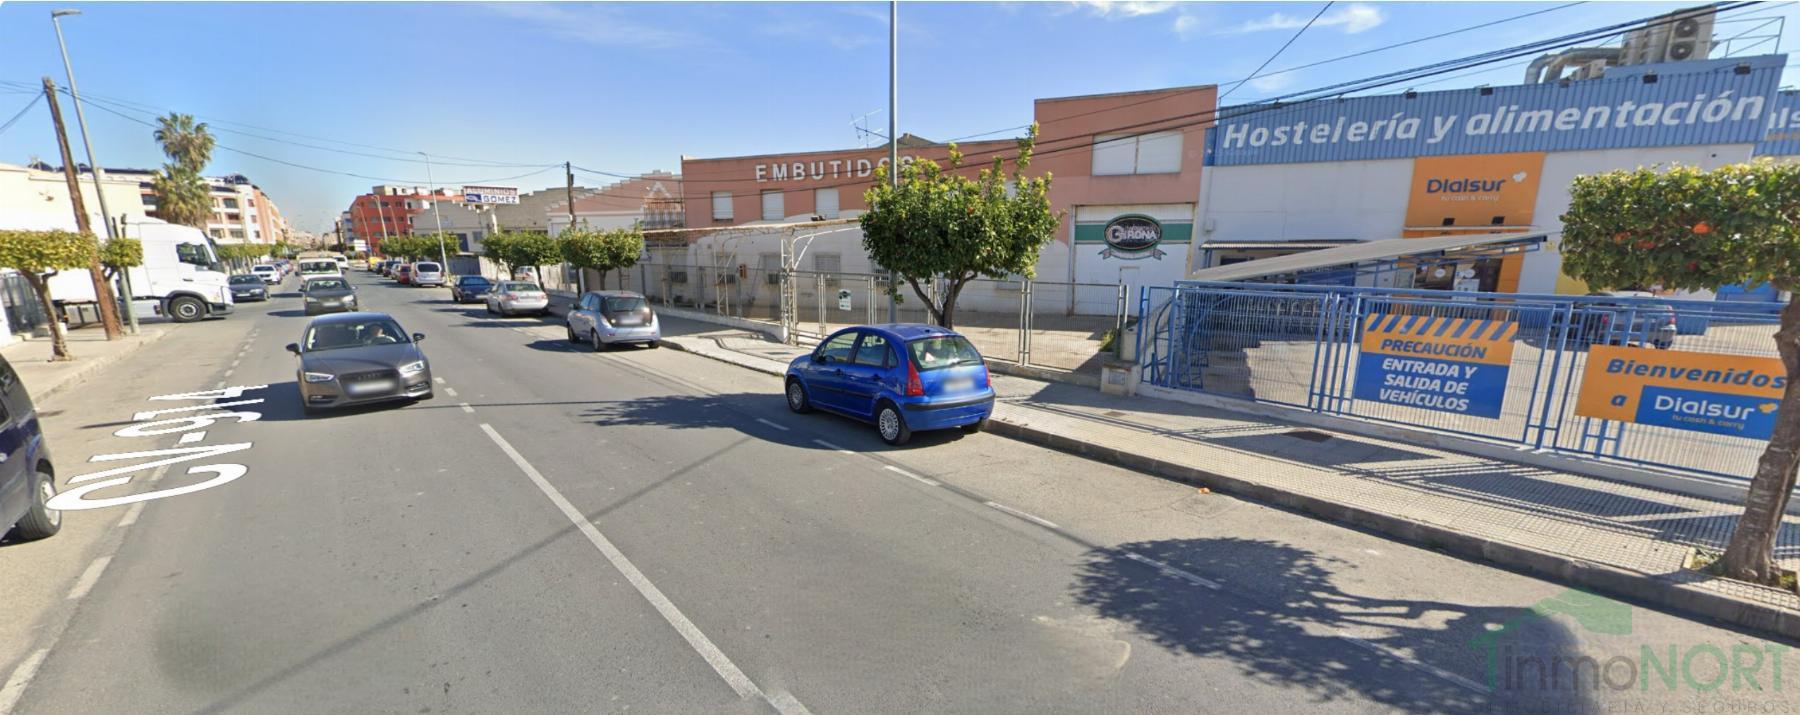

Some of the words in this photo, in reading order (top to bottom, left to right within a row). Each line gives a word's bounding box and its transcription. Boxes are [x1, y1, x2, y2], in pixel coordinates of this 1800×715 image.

[1222, 112, 1421, 149] Hostelería
[1426, 114, 1458, 144] y
[1465, 90, 1765, 136] alimentación
[1426, 178, 1507, 194] Dialsur
[483, 195, 517, 204] GOMEZ
[1381, 338, 1487, 359] PRECAUCIÓN
[1382, 358, 1459, 377] ENTRADA
[1464, 366, 1478, 379] Y
[1606, 358, 1787, 389] Bienvenidos
[1384, 374, 1441, 394] SALIDA
[1443, 380, 1469, 395] DE
[1379, 388, 1470, 412] VEHÍCULOS
[1610, 394, 1627, 407] a
[1654, 395, 1755, 420] Dialsur
